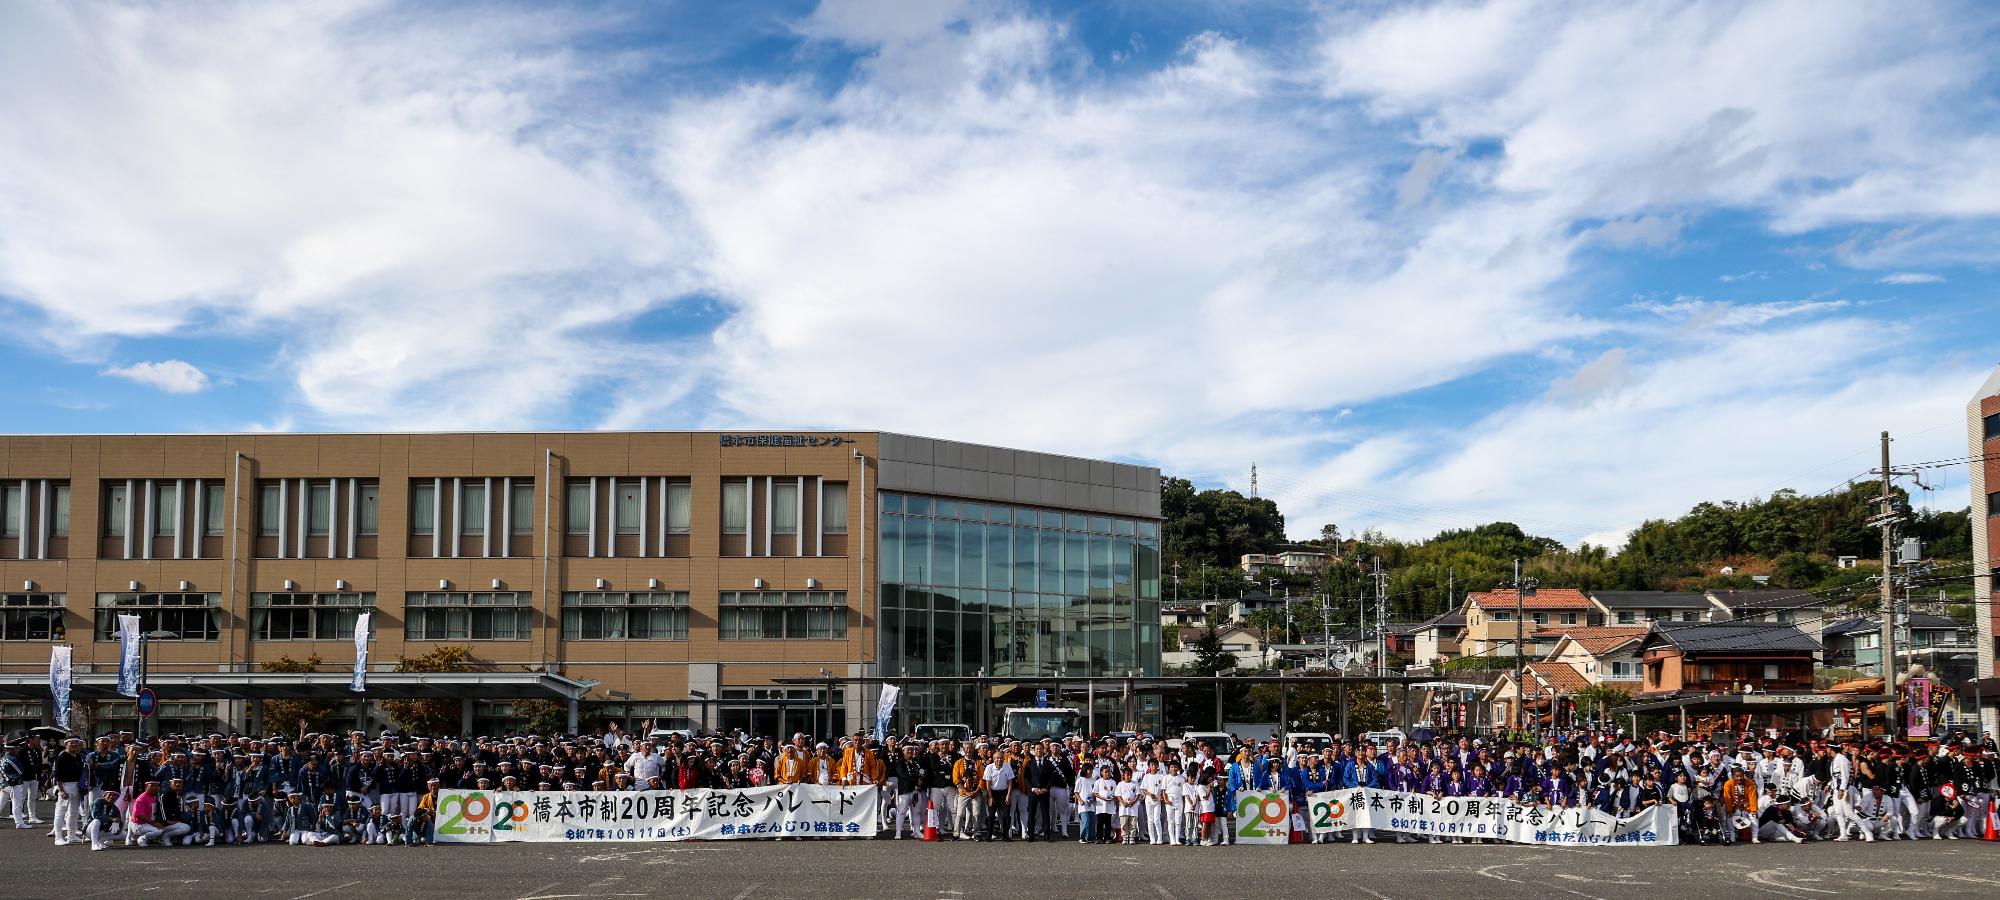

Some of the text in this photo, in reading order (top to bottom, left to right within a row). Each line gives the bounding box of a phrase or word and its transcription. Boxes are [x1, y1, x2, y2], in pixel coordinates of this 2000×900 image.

[720, 434, 856, 447] 橋本市保健福祉センター
[720, 821, 861, 835] 橋本だんじり協議会
